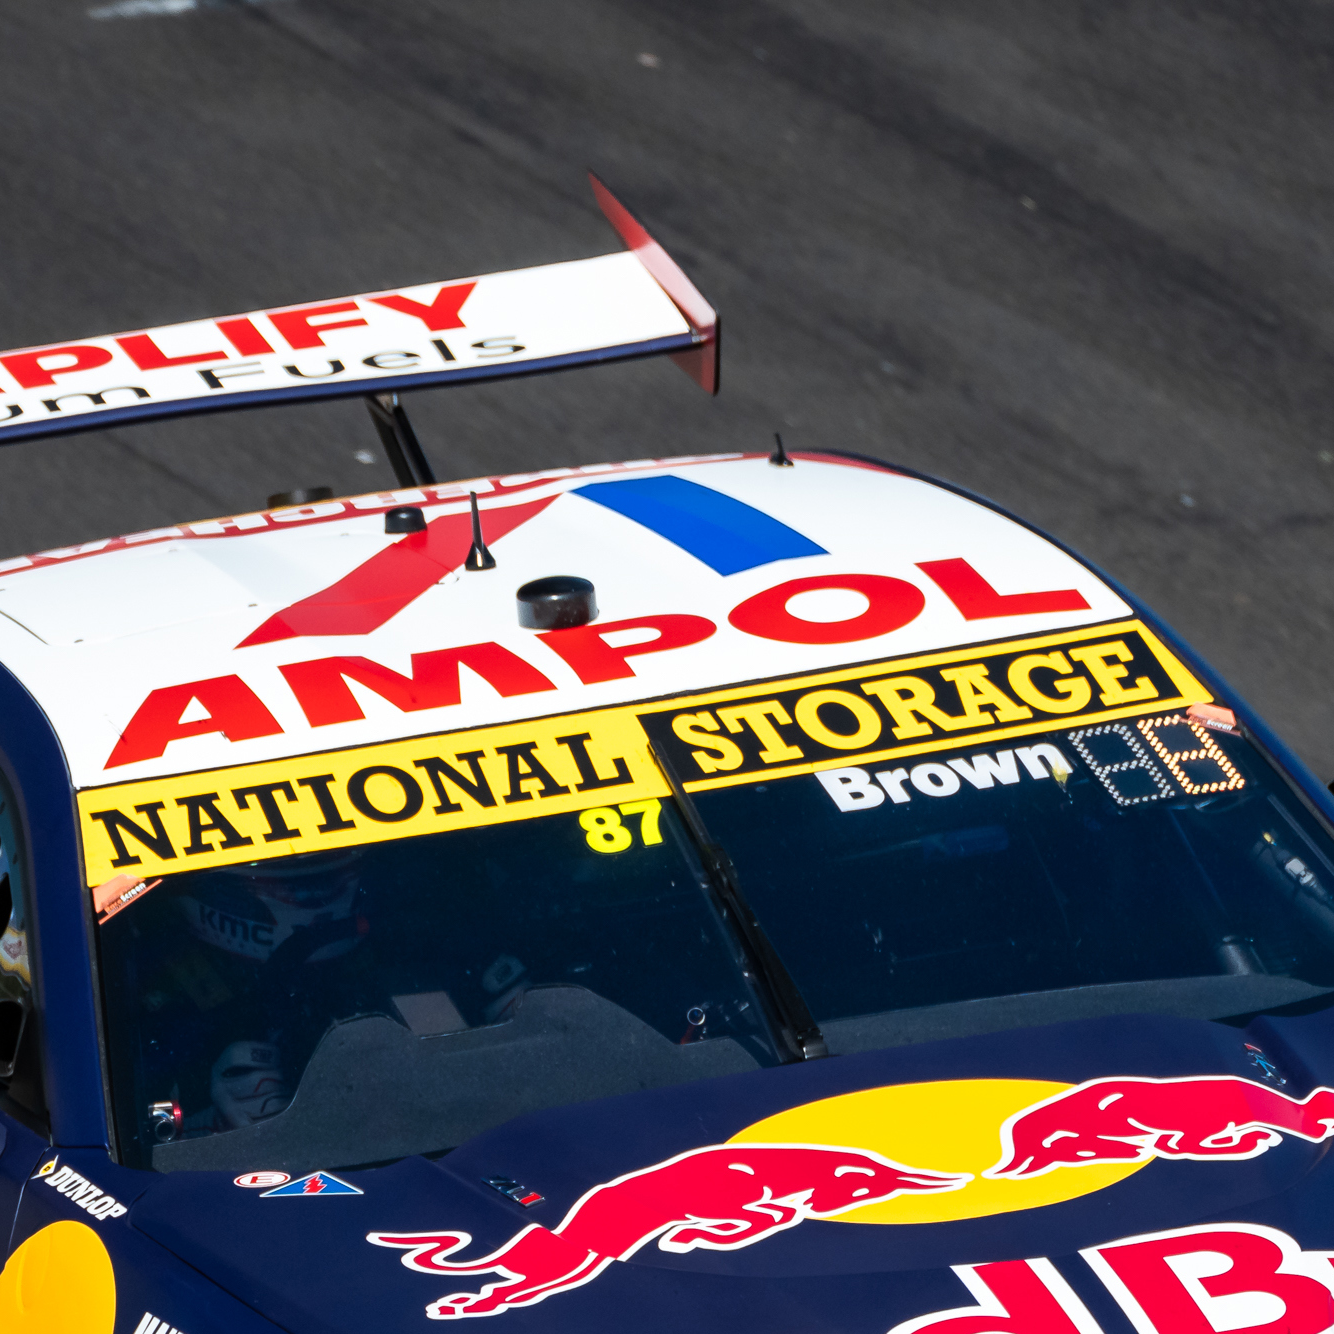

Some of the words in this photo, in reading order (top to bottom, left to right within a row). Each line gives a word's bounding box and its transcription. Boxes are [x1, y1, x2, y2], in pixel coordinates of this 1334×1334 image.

[197, 335, 526, 389] Fuels
[103, 557, 1092, 770] AMPOL
[90, 731, 633, 867] NATIONAL
[670, 641, 1160, 773] STORAGE
[815, 742, 1073, 812] Brown
[578, 798, 663, 855] 87
[44, 1165, 128, 1221] DUNLOP
